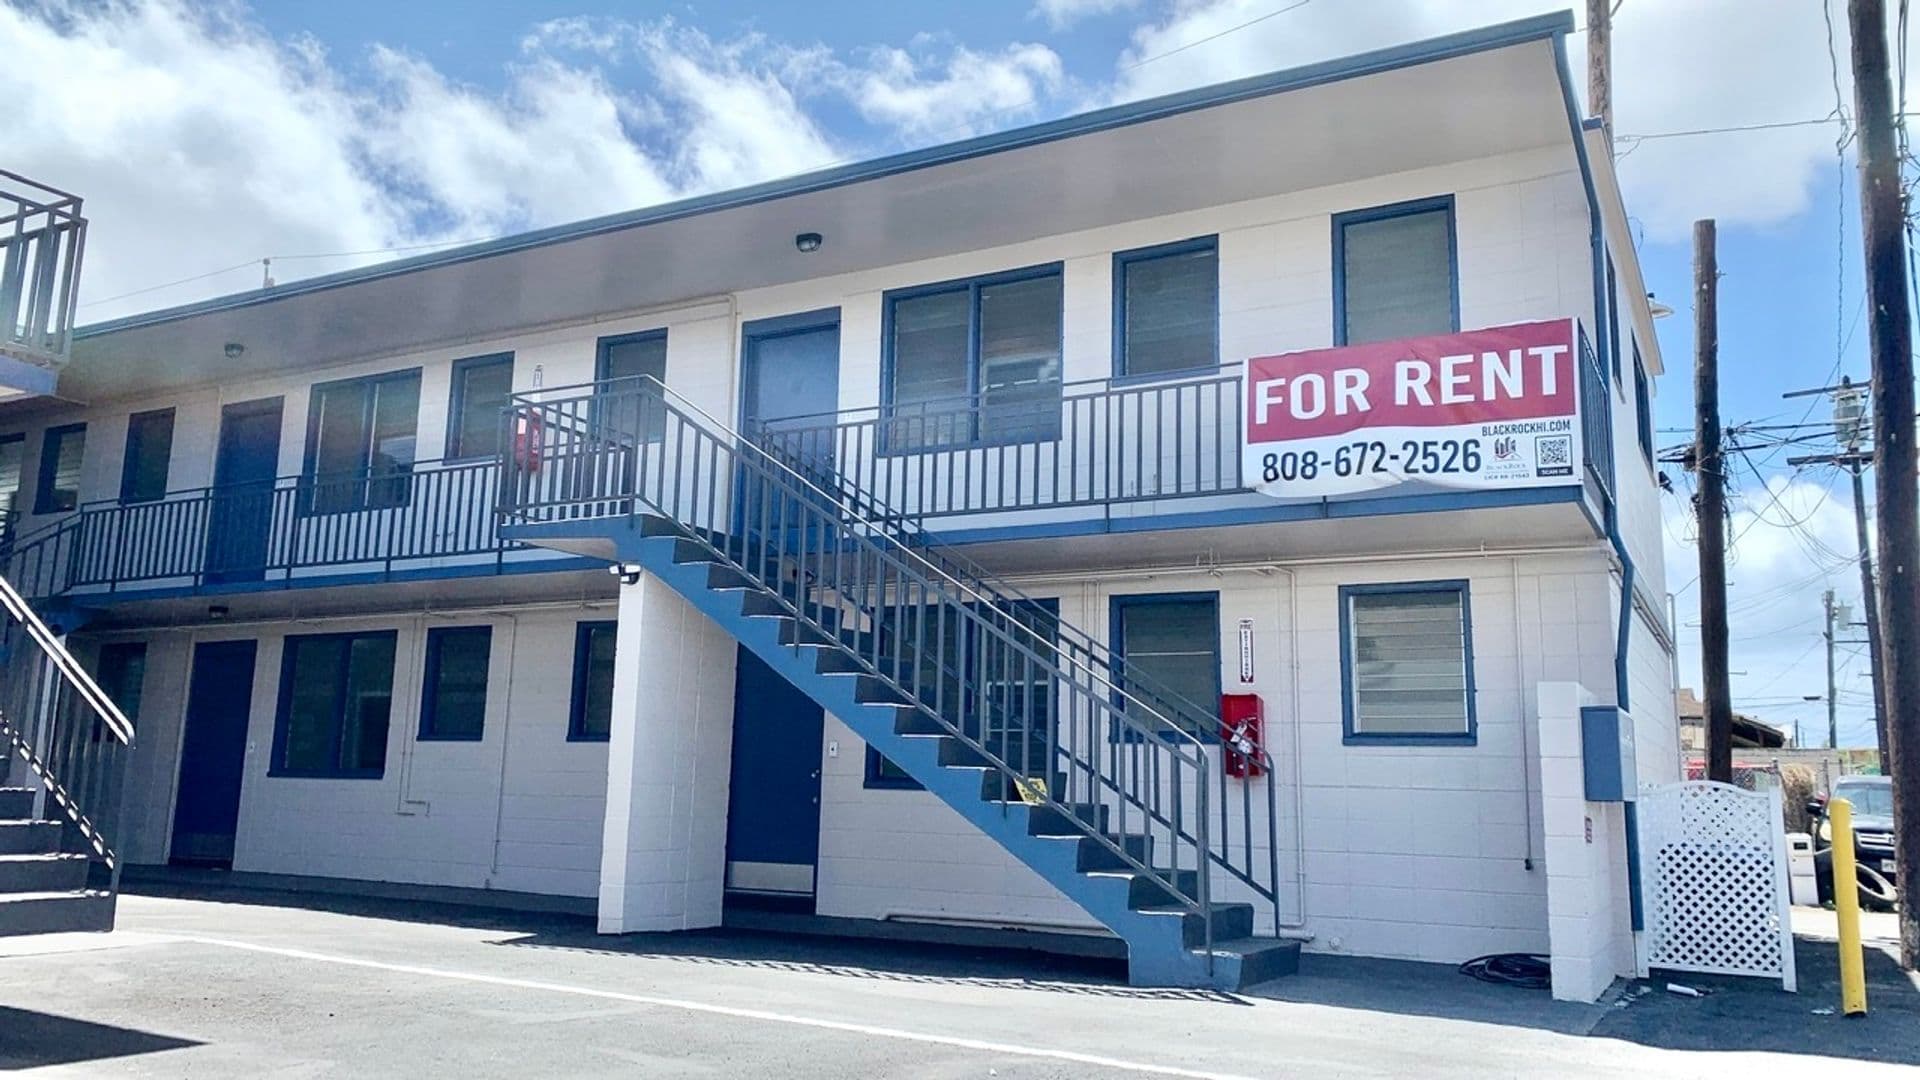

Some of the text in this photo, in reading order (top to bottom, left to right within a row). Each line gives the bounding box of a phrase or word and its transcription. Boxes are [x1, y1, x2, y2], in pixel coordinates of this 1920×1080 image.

[1255, 344, 1568, 425] FOR RENT
[1482, 420, 1570, 436] BLACKROCKHI.COM
[1262, 439, 1481, 483] 808-672-2526
